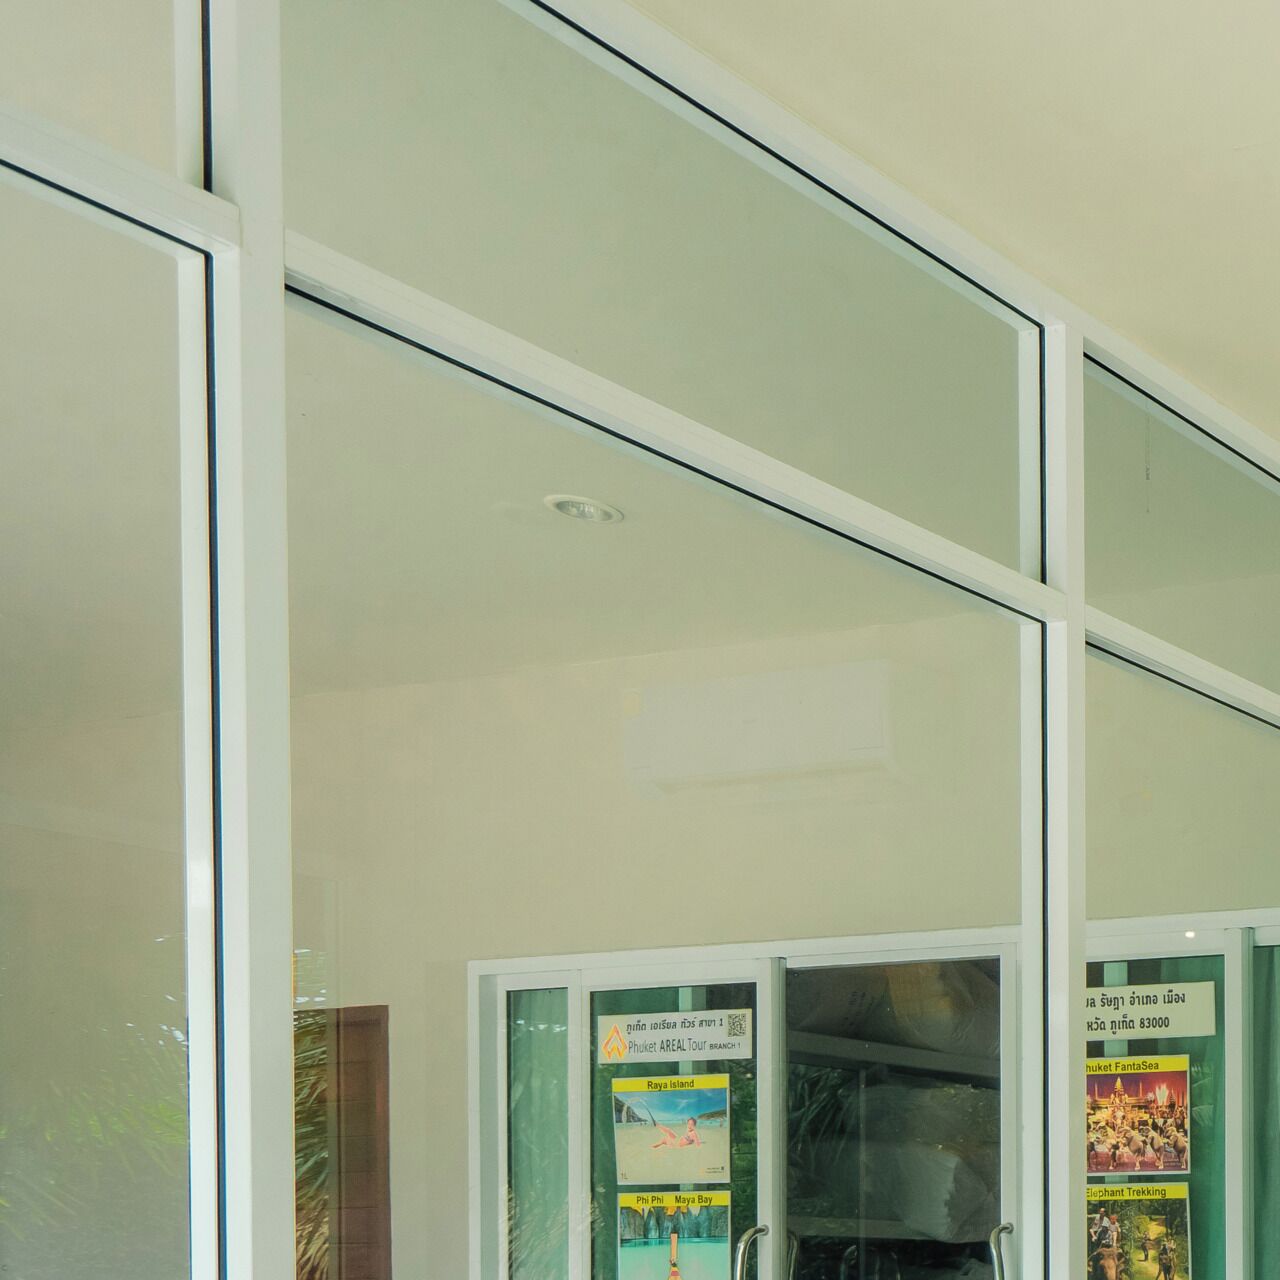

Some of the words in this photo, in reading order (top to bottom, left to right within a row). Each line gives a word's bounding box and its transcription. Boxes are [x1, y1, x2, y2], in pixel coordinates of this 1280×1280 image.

[1163, 989, 1186, 1004] เมือง
[1139, 1017, 1170, 1029] 83000
[628, 1041, 657, 1053] Phuket
[660, 1038, 686, 1052] AREAL
[688, 1038, 707, 1051] Tour
[709, 1042, 736, 1050] BRANCH
[1086, 1063, 1112, 1073] huket
[1114, 1061, 1159, 1072] FantaSea
[647, 1080, 668, 1091] Raya
[1127, 1187, 1167, 1198] Trekking
[636, 1195, 649, 1204] Phi
[651, 1195, 664, 1204] Phi
[674, 1195, 696, 1206] Maya
[697, 1194, 713, 1205] Bay
